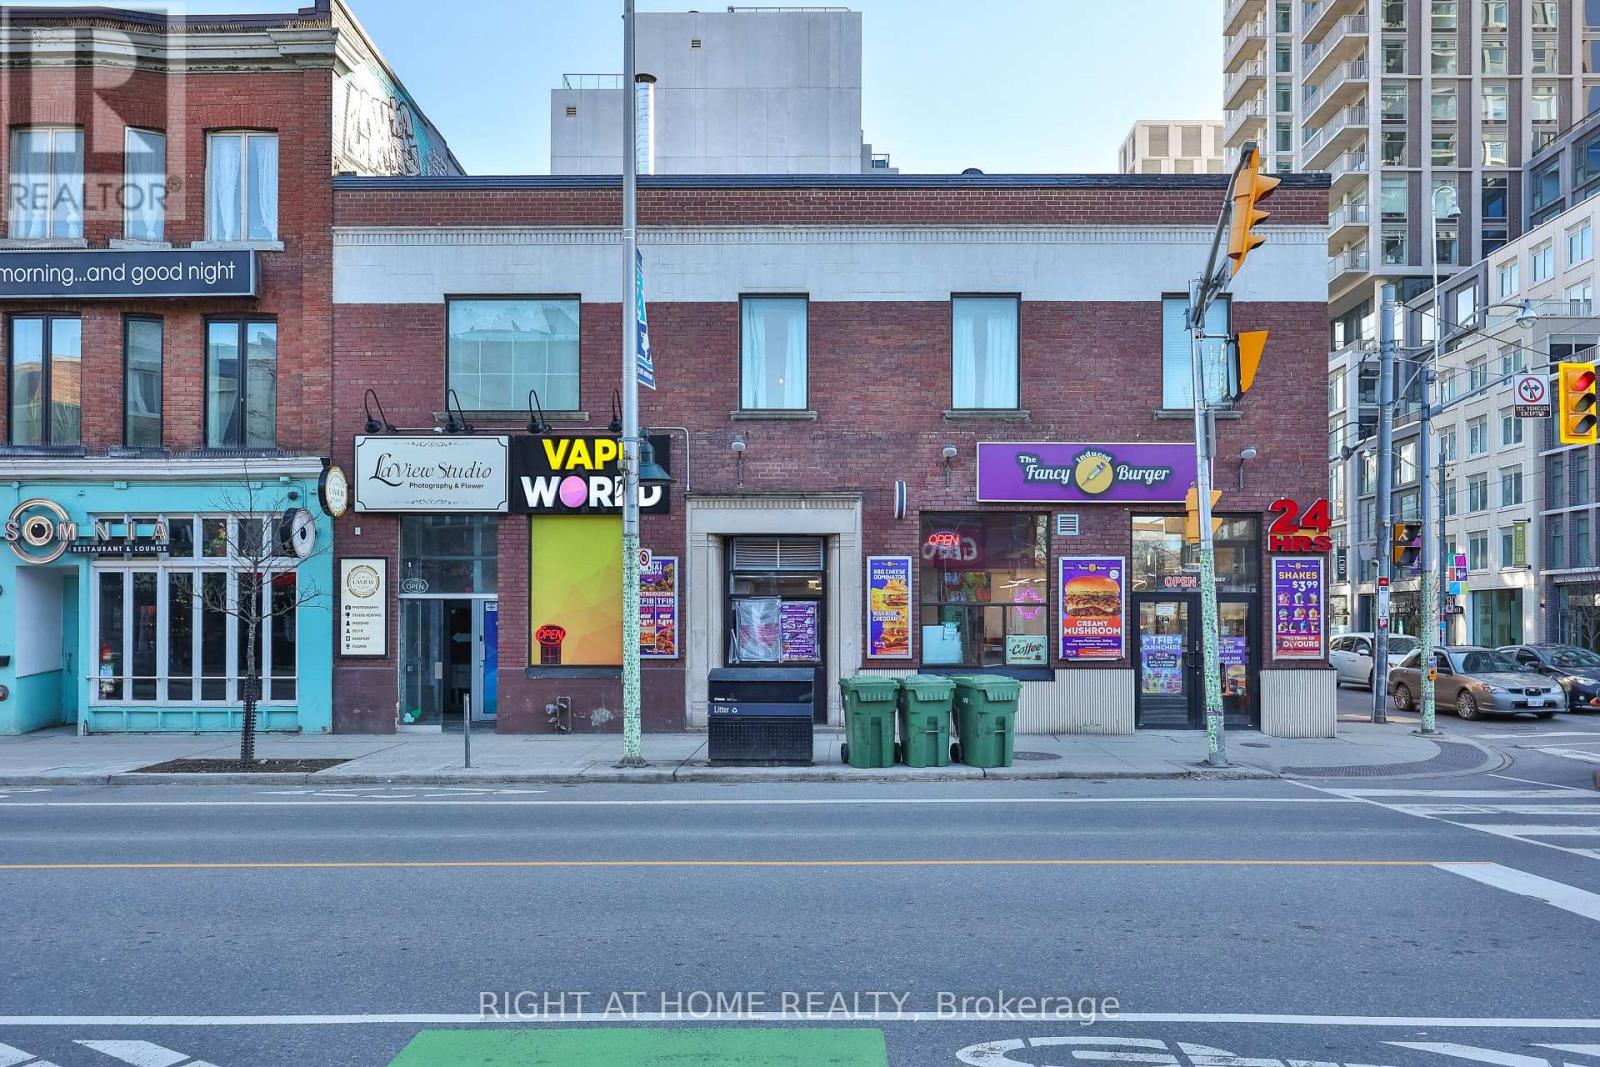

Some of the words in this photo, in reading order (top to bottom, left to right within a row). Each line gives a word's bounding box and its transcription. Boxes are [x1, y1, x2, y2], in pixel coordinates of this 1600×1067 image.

[131, 262, 183, 285] good
[188, 261, 236, 284] night
[541, 438, 625, 471] VAP
[1019, 455, 1037, 463] The
[1075, 450, 1112, 463] induced
[437, 460, 492, 480] Studio
[1026, 464, 1071, 484] Fancy
[1116, 464, 1170, 485] Burger
[409, 482, 453, 490] Photography
[1267, 497, 1332, 533] 24
[4, 515, 170, 547] SOMNIA
[928, 534, 960, 546] OPEN
[1267, 534, 1333, 552] HRS
[1278, 571, 1318, 580] SHAKES
[1164, 576, 1197, 588] OPEN
[537, 629, 564, 641] OPEN
[1063, 627, 1121, 635] MUSHROOM
[1151, 636, 1173, 645] TFIB
[1012, 640, 1042, 656] Coffee
[713, 705, 730, 714] Litter
